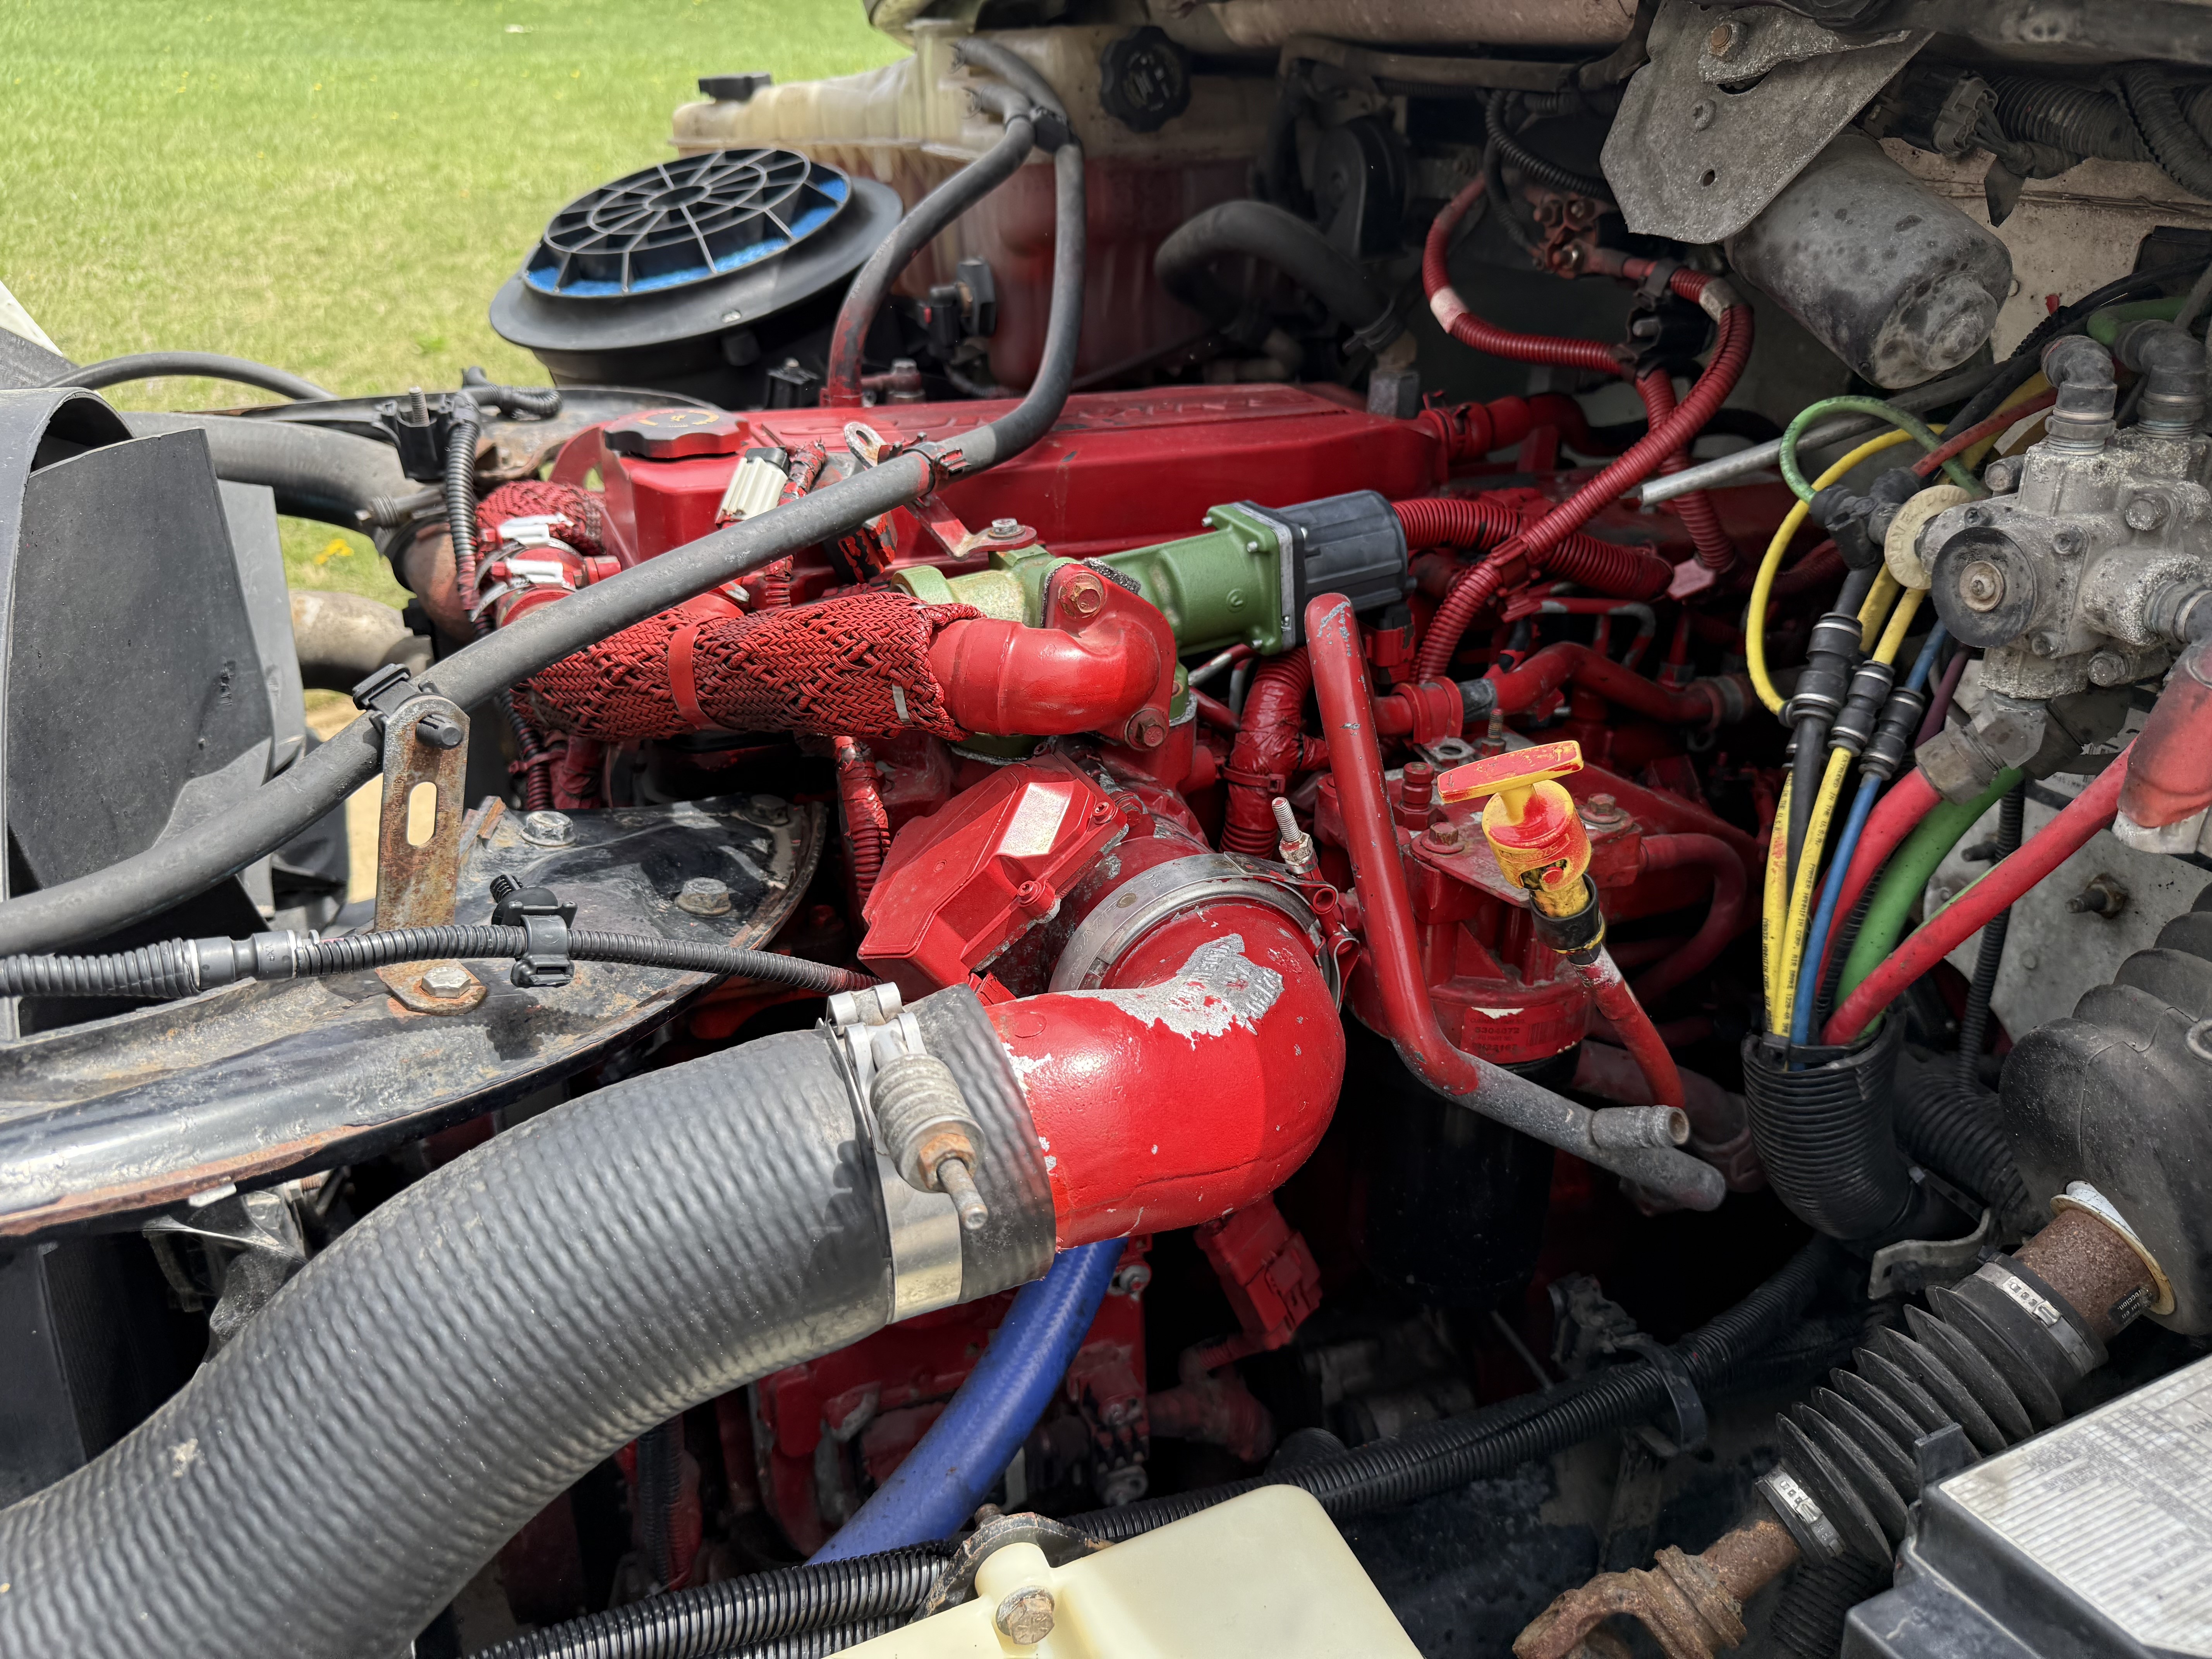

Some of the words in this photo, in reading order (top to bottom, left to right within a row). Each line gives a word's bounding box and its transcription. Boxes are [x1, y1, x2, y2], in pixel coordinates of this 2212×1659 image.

[1833, 754, 1849, 788] EXTRUDED
[1829, 792, 1835, 801] IN
[1824, 805, 1832, 817] THE
